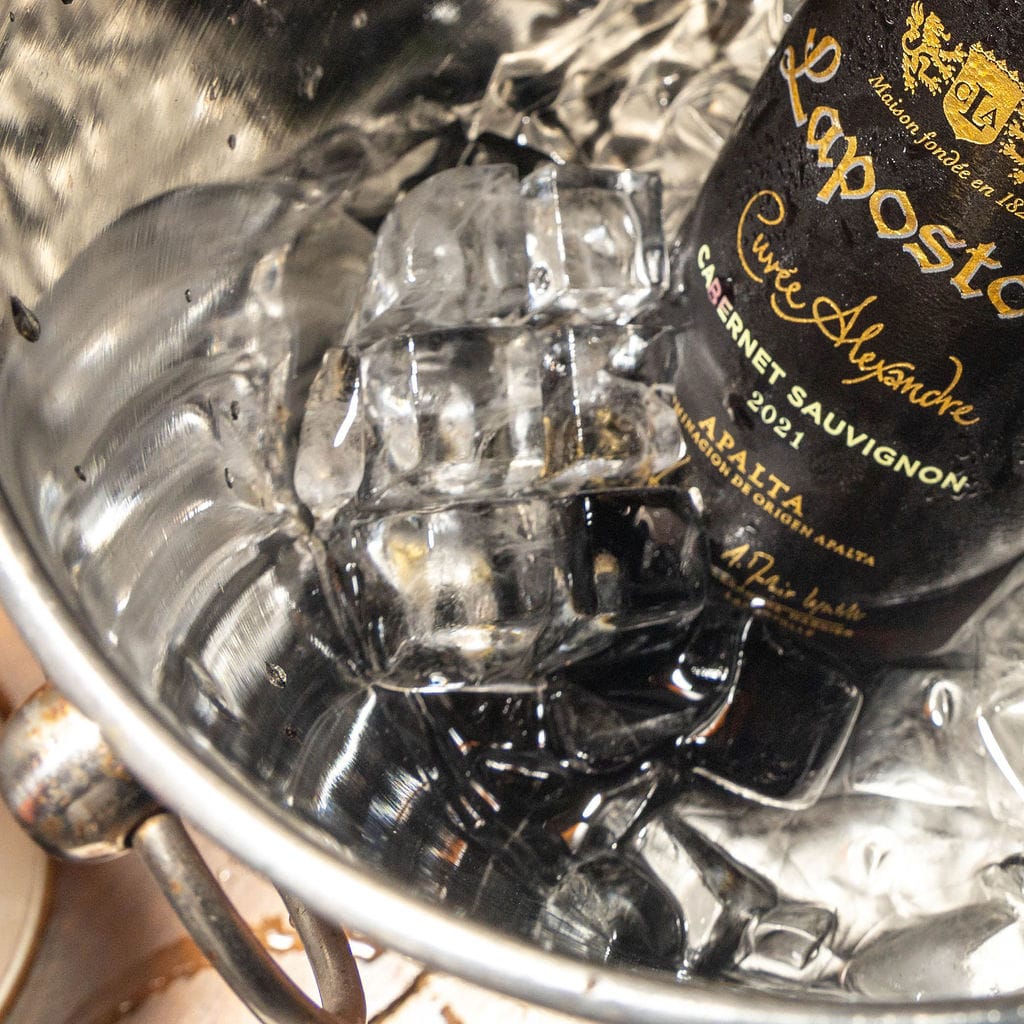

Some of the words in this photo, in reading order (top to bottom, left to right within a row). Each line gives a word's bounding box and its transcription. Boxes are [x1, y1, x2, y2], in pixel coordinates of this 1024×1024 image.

[867, 73, 920, 136] Maison
[915, 128, 971, 180] fondée
[970, 178, 995, 197] en
[736, 189, 806, 309] Cuvée
[697, 244, 787, 385] CABERNET
[786, 385, 968, 493] SAUVIGNON
[746, 390, 805, 450] 2021
[770, 295, 981, 425] Alexandre
[698, 415, 804, 517] APALTA
[730, 474, 751, 496] DE
[752, 492, 813, 538] ORIGEN
[813, 534, 876, 568] APALTA
